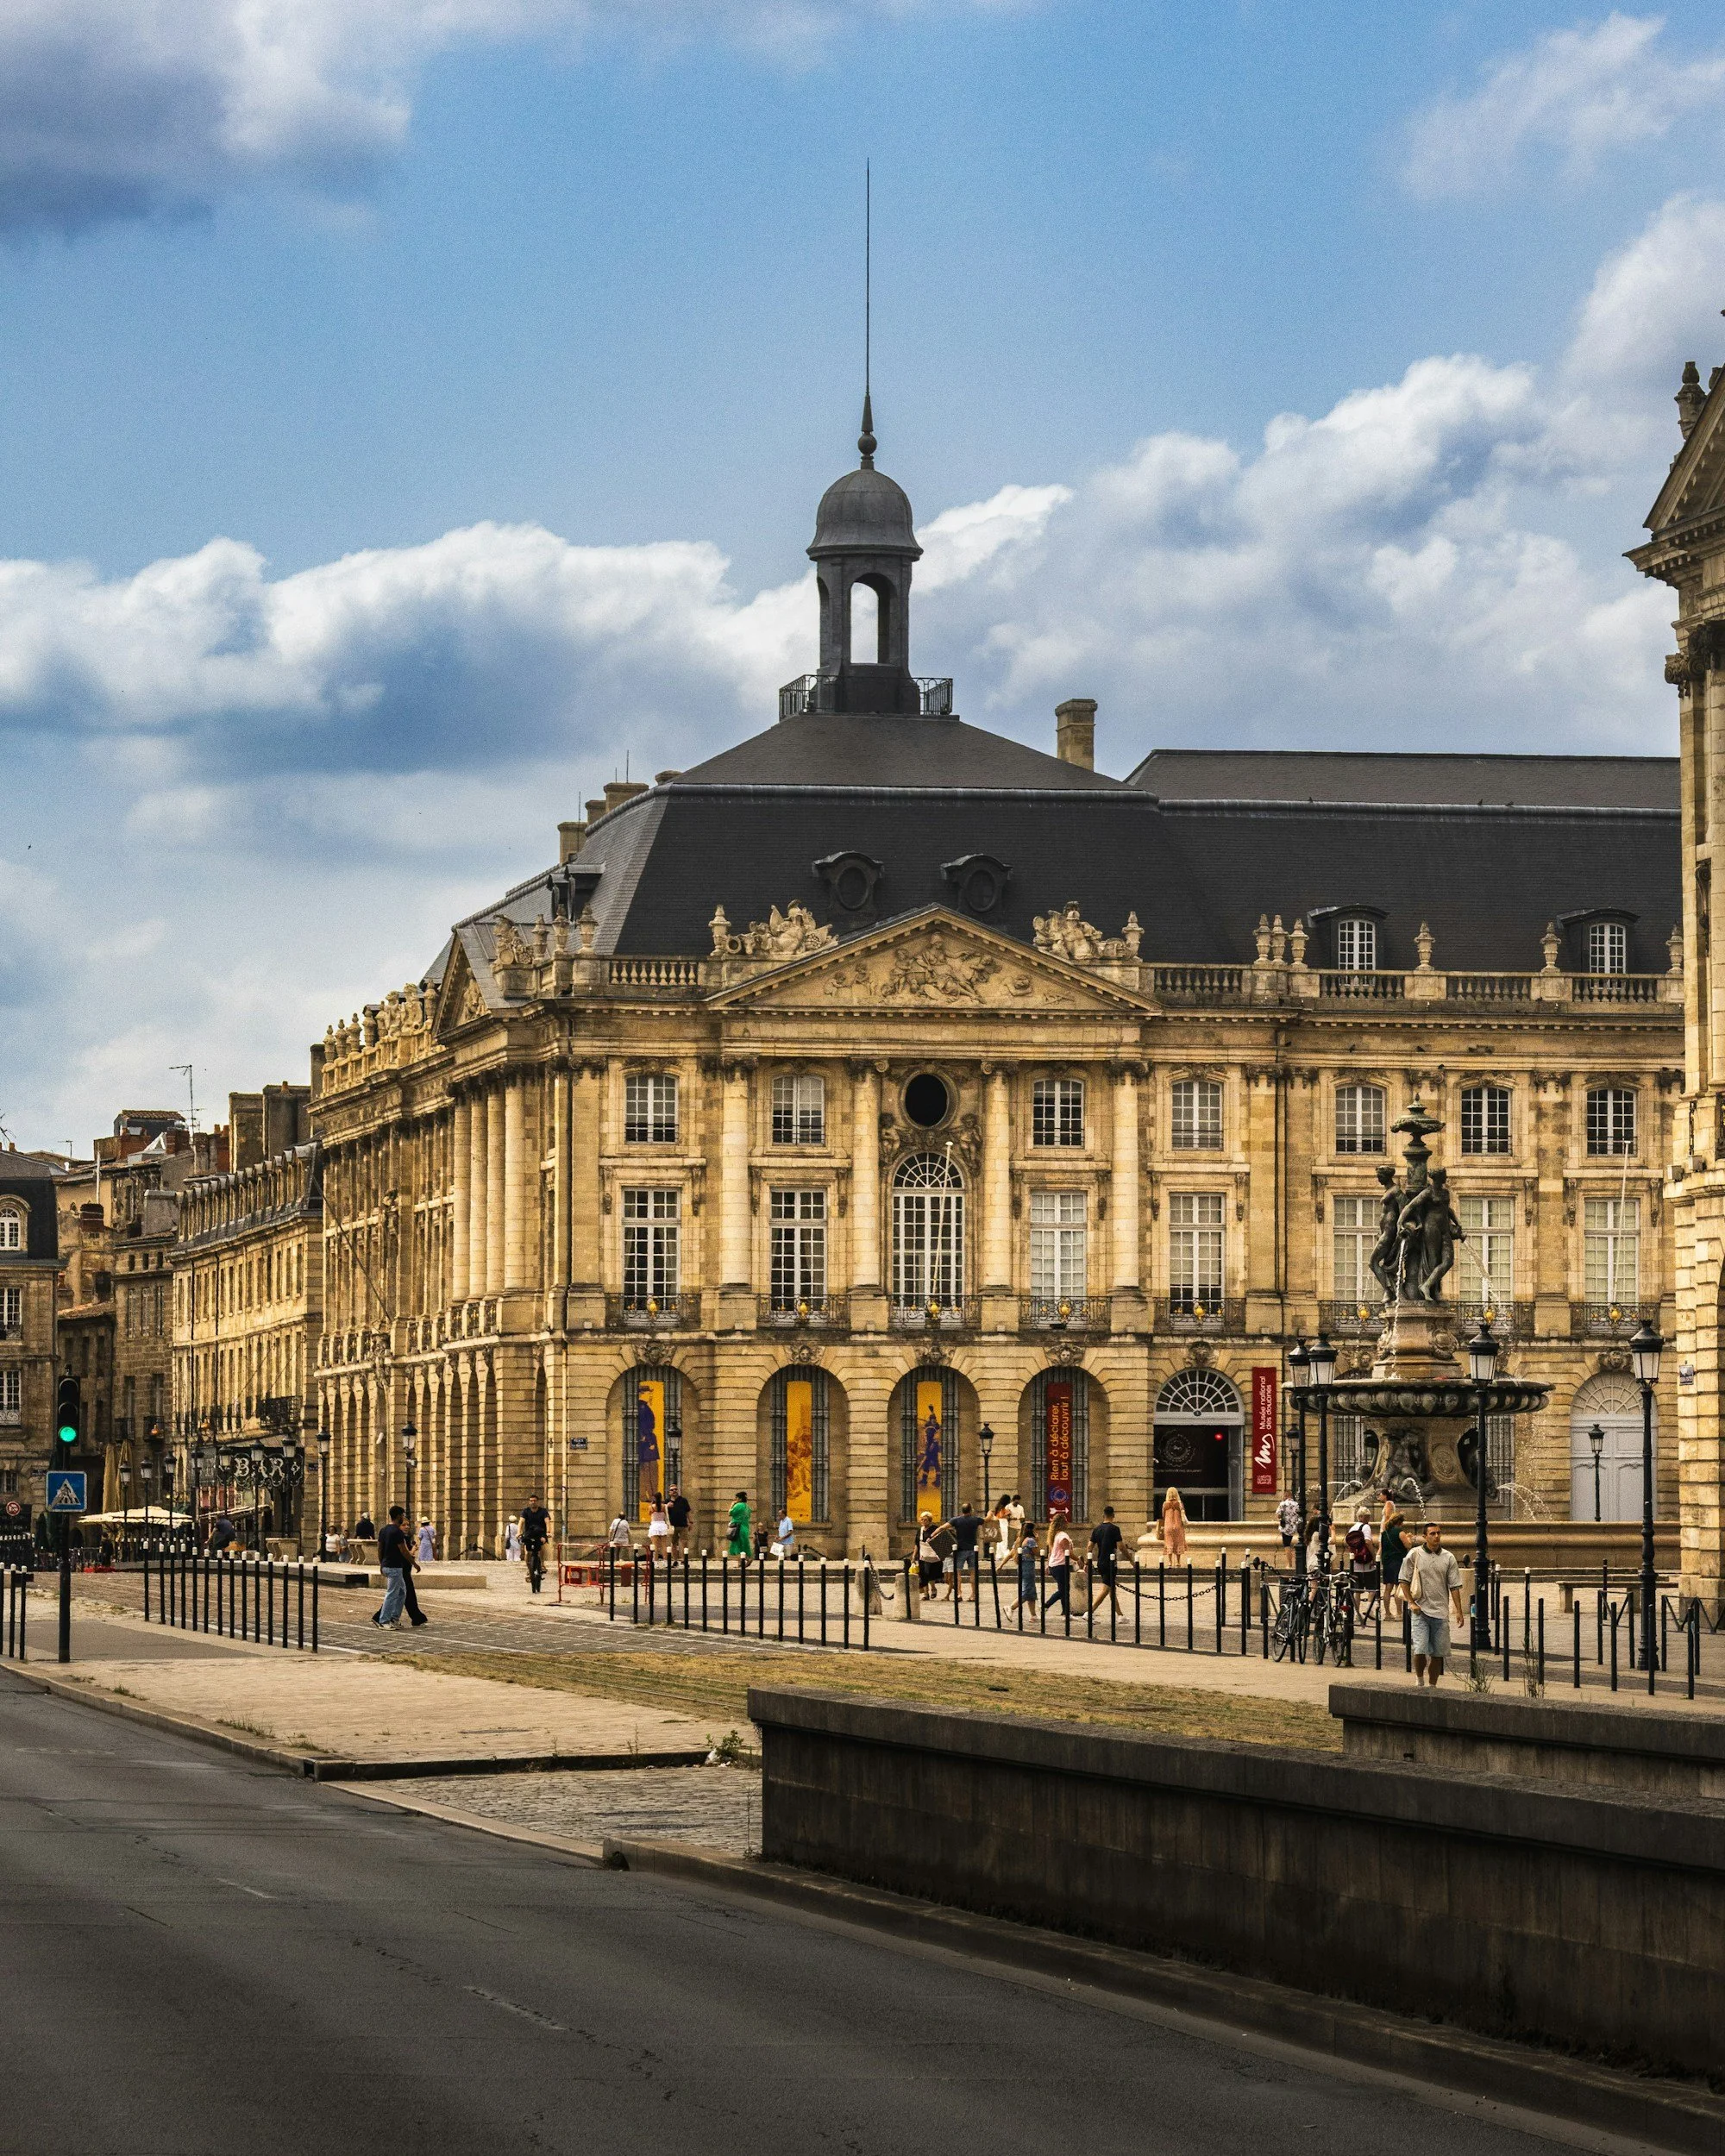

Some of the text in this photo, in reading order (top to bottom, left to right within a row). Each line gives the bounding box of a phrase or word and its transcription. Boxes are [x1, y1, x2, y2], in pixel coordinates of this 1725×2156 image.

[1050, 1402, 1060, 1447] déclarer,
[1060, 1401, 1069, 1450] découvrir
[234, 1457, 285, 1477] BAR
[1051, 1460, 1059, 1481] Rien
[1060, 1462, 1069, 1481] tout
